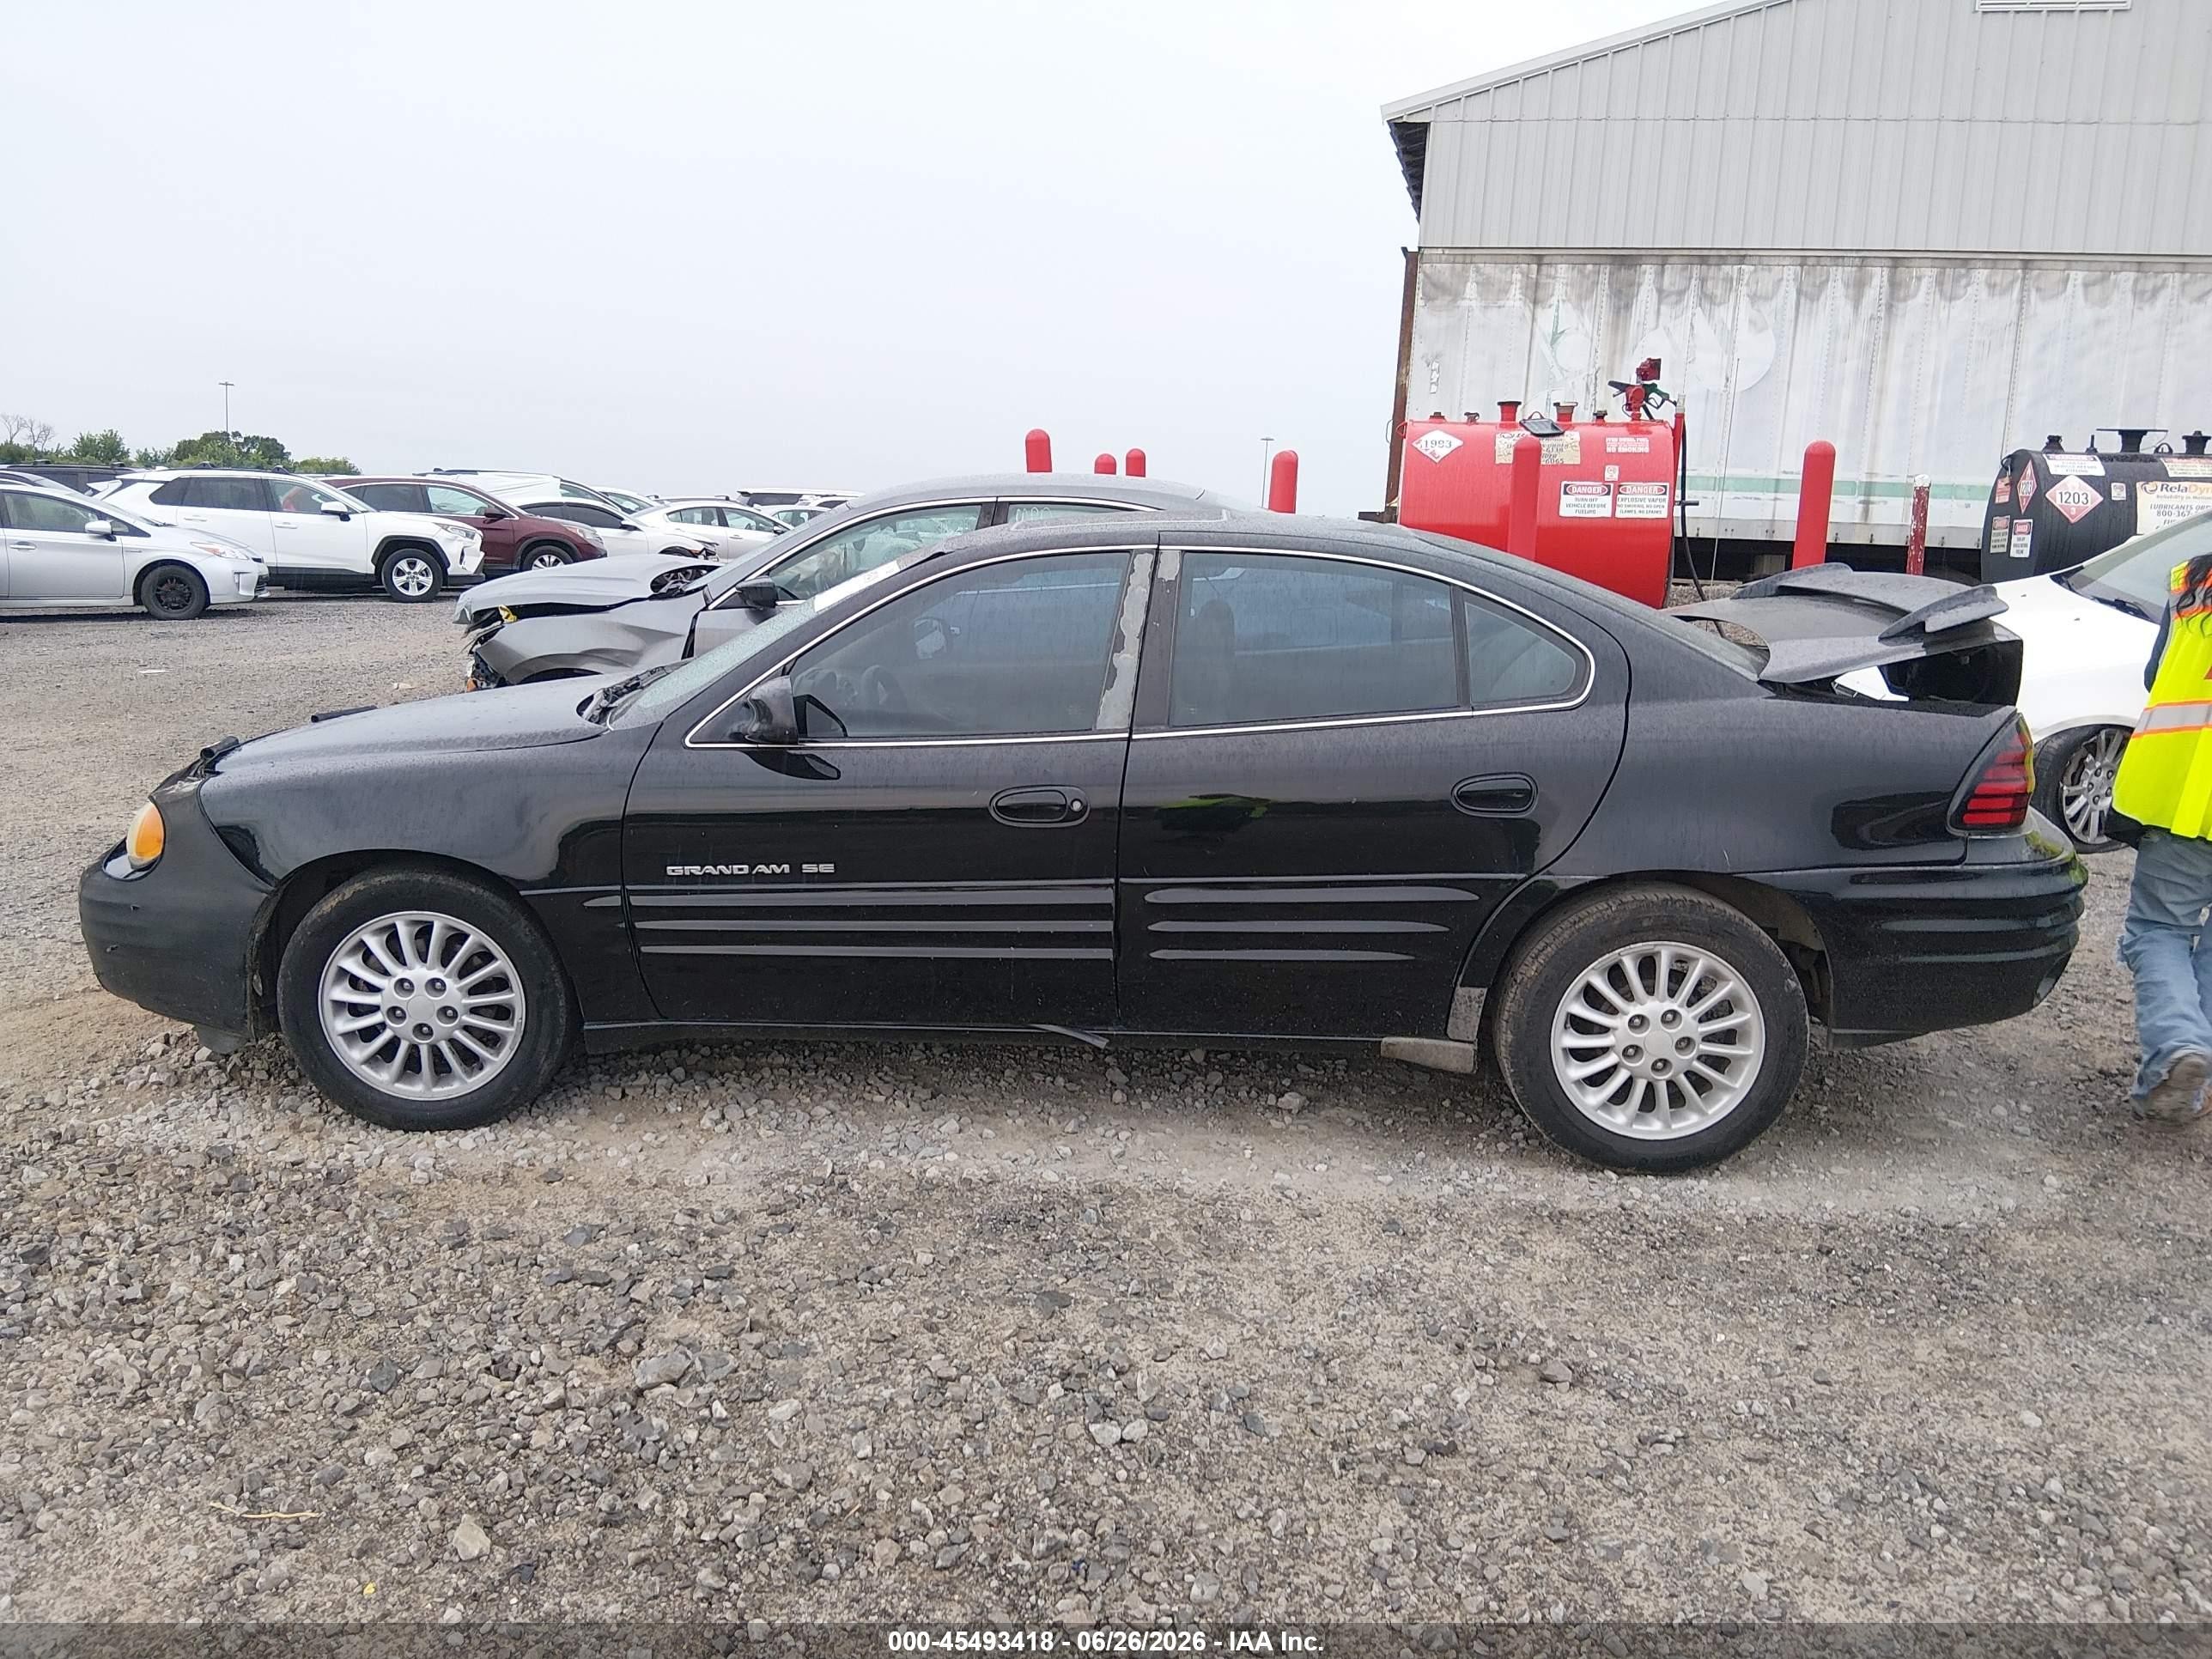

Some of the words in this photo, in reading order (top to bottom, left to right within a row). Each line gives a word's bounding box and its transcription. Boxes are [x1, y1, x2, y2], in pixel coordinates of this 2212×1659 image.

[1626, 486, 1658, 495] DANGER
[2160, 483, 2212, 495] RelaDyn
[2058, 491, 2089, 505] 1203
[666, 865, 749, 876] GRAND
[751, 864, 790, 874] AM
[802, 863, 835, 873] SE
